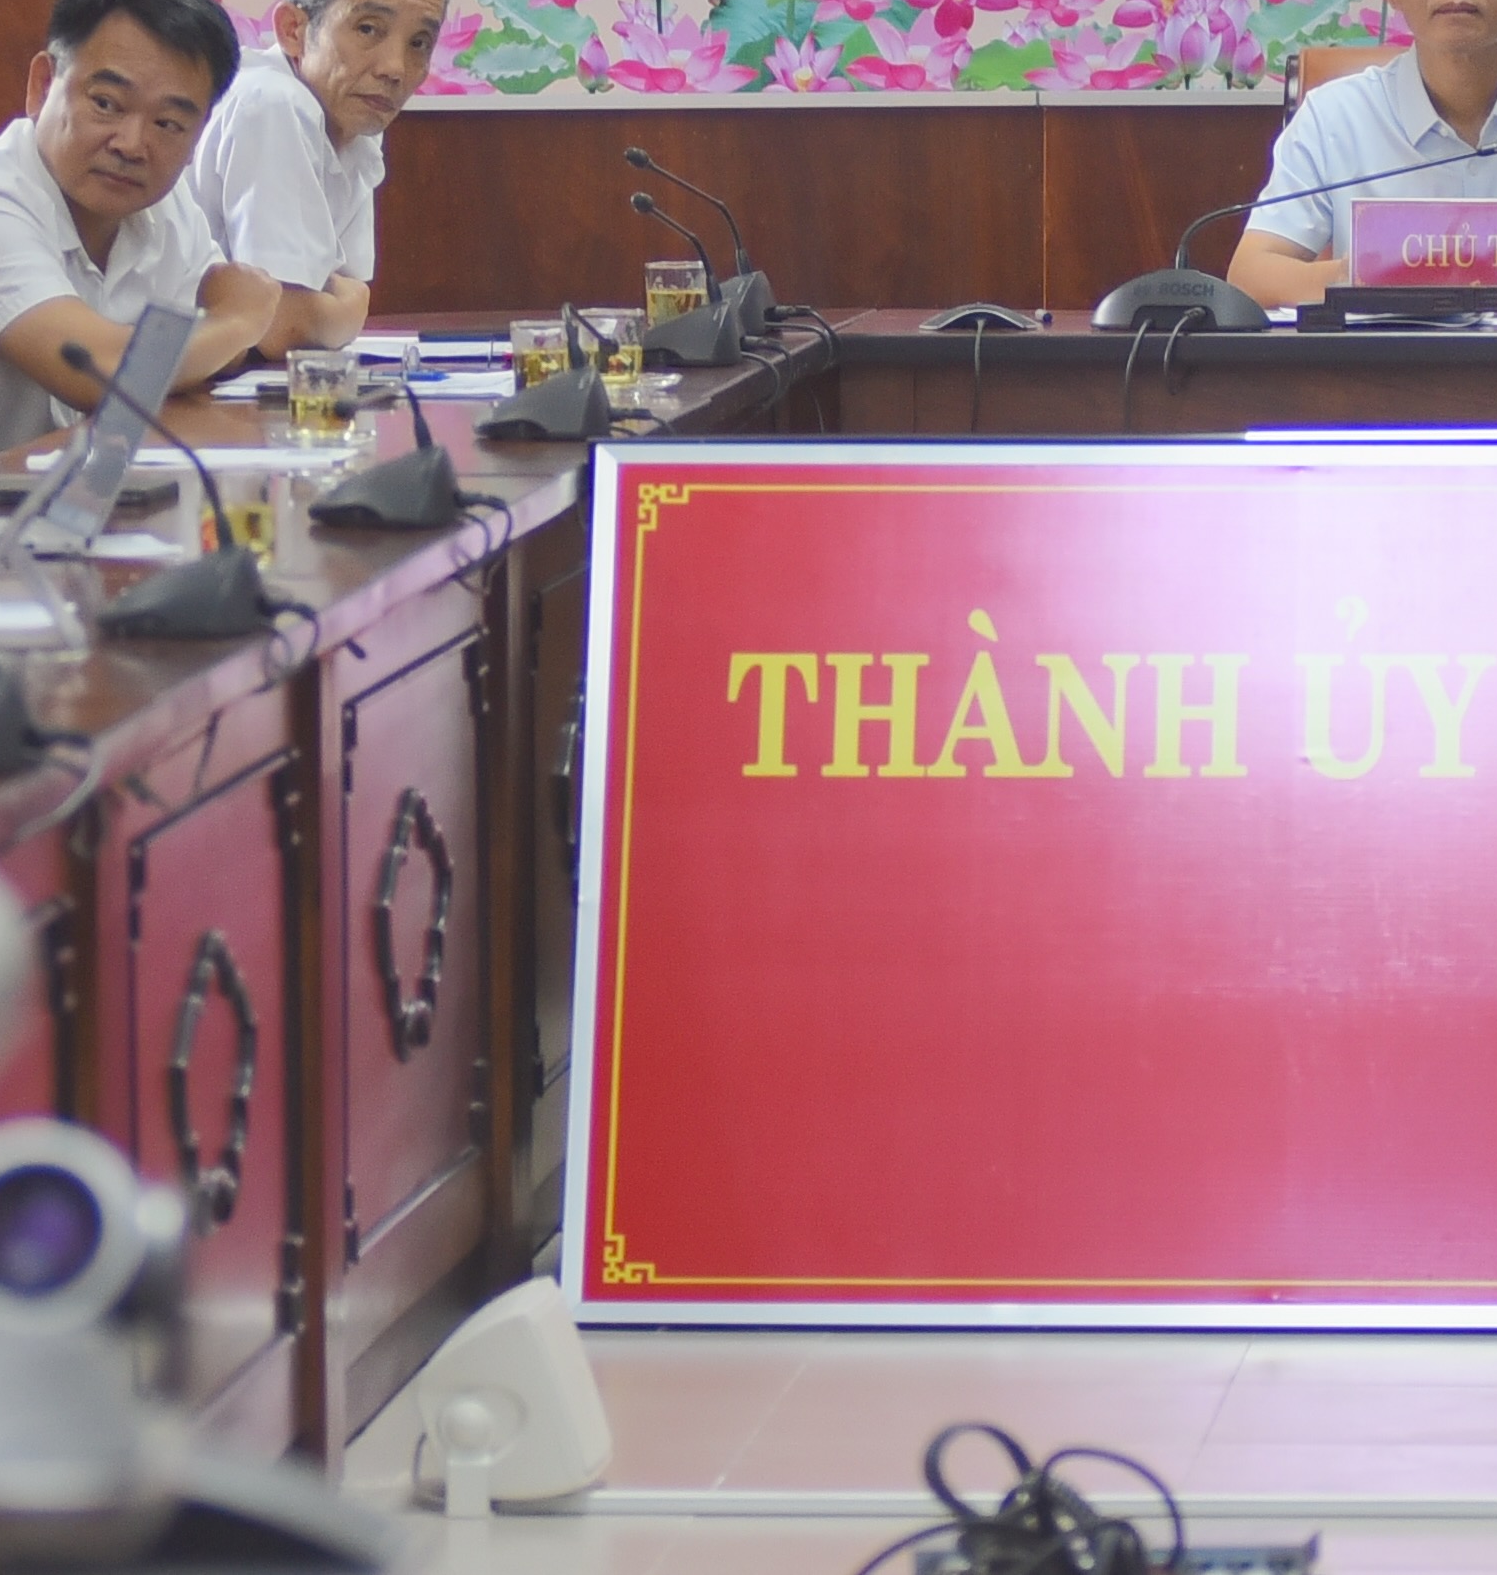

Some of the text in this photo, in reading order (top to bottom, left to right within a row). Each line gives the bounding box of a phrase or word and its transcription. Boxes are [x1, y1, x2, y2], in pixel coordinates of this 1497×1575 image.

[1402, 222, 1478, 268] CHỦ
[1157, 283, 1215, 297] BOSCH
[727, 609, 1249, 778] THÀNH
[1294, 594, 1497, 780] ỦY
